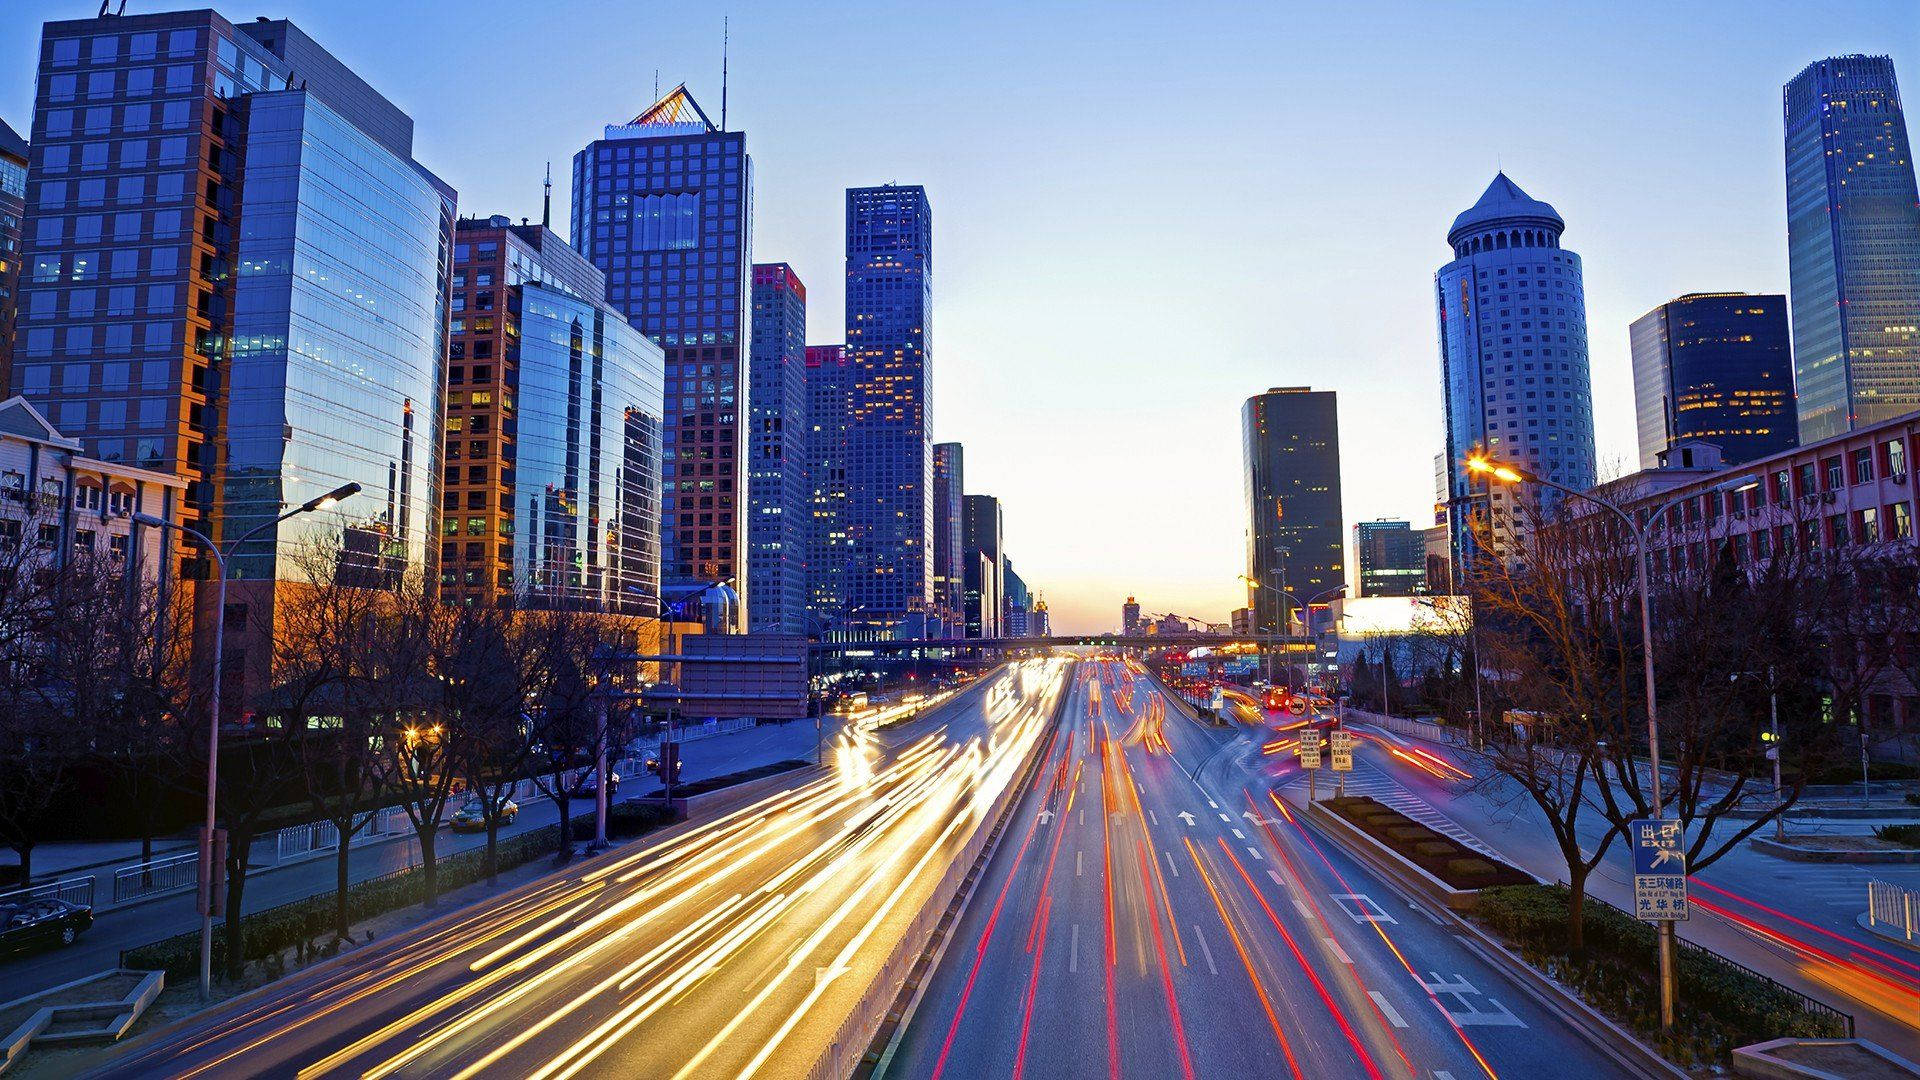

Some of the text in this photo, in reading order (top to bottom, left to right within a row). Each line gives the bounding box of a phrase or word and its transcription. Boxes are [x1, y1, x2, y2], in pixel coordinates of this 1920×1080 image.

[1641, 824, 1675, 839] 出口
[1638, 877, 1683, 889] 东三环辅路
[1640, 899, 1684, 910] 光华桥
